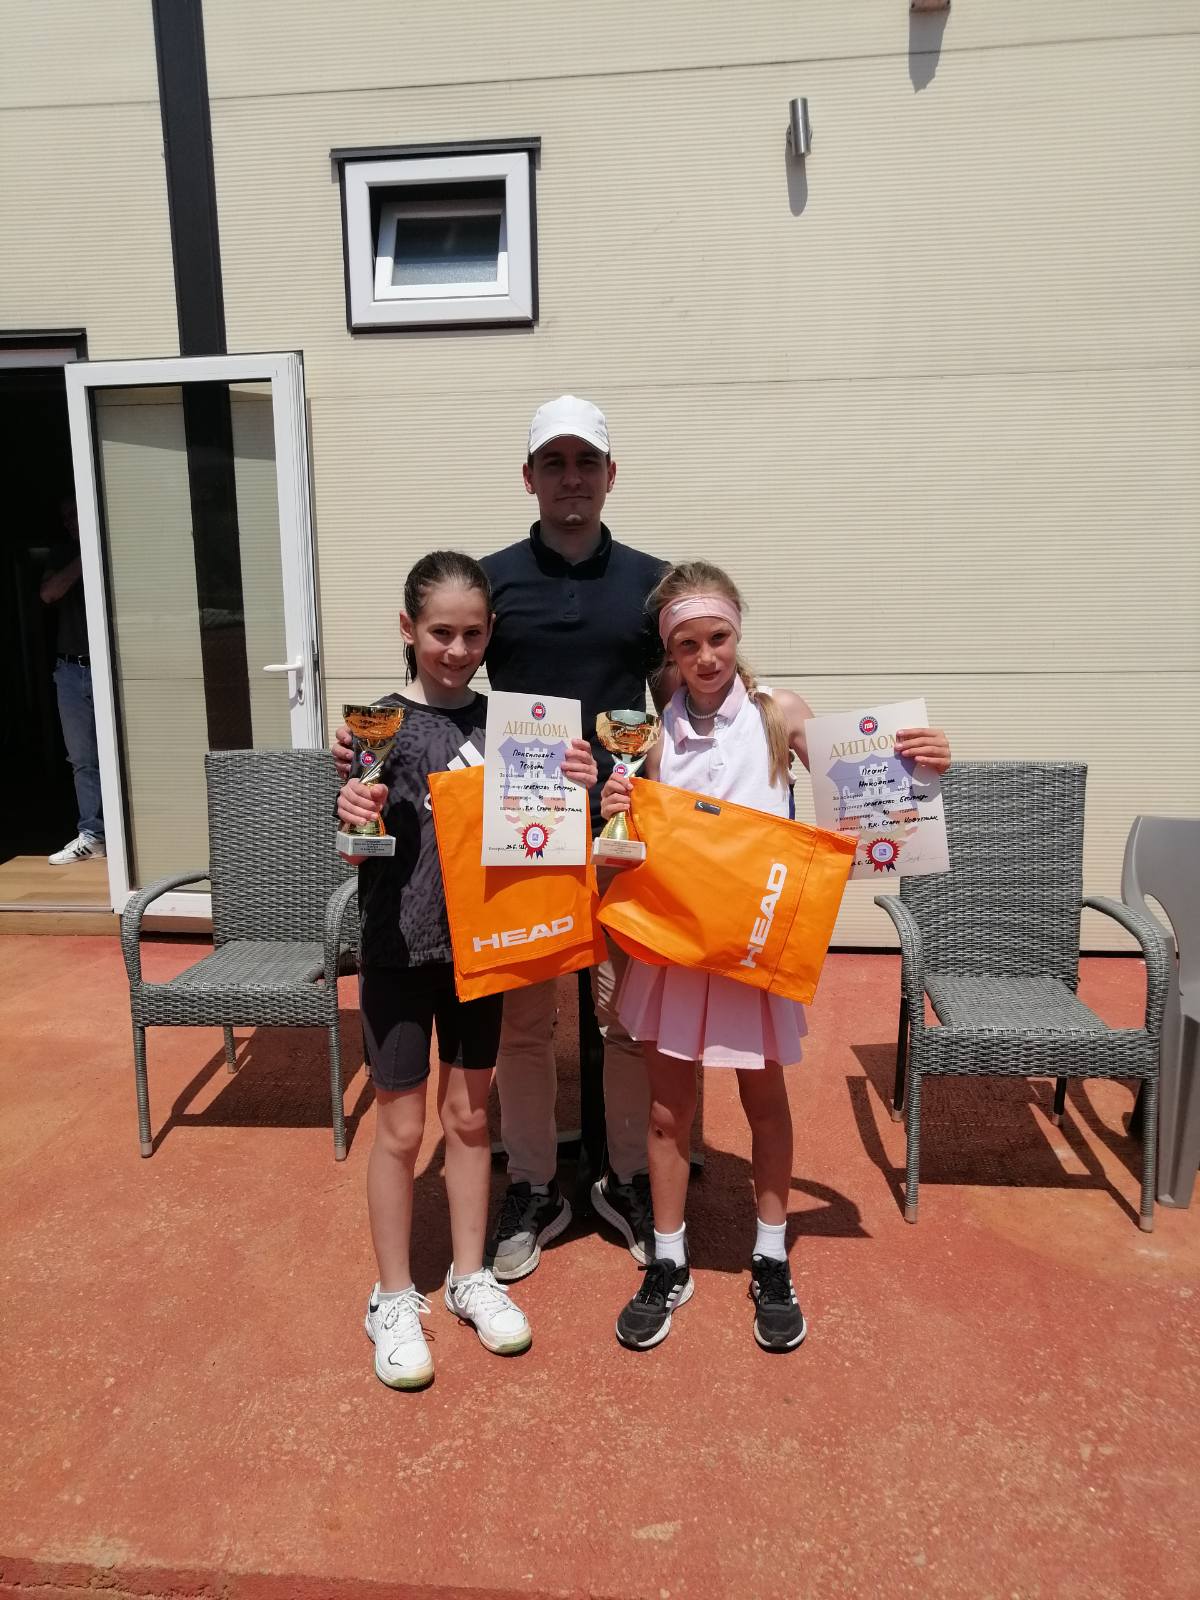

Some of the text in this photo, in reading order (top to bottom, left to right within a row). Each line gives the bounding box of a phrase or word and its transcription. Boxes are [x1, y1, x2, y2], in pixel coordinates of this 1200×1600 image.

[503, 720, 569, 738] ДИПЛОМА
[829, 734, 897, 760] ДИПЛОМ
[739, 862, 788, 969] HEAD
[472, 915, 575, 953] HEAD
